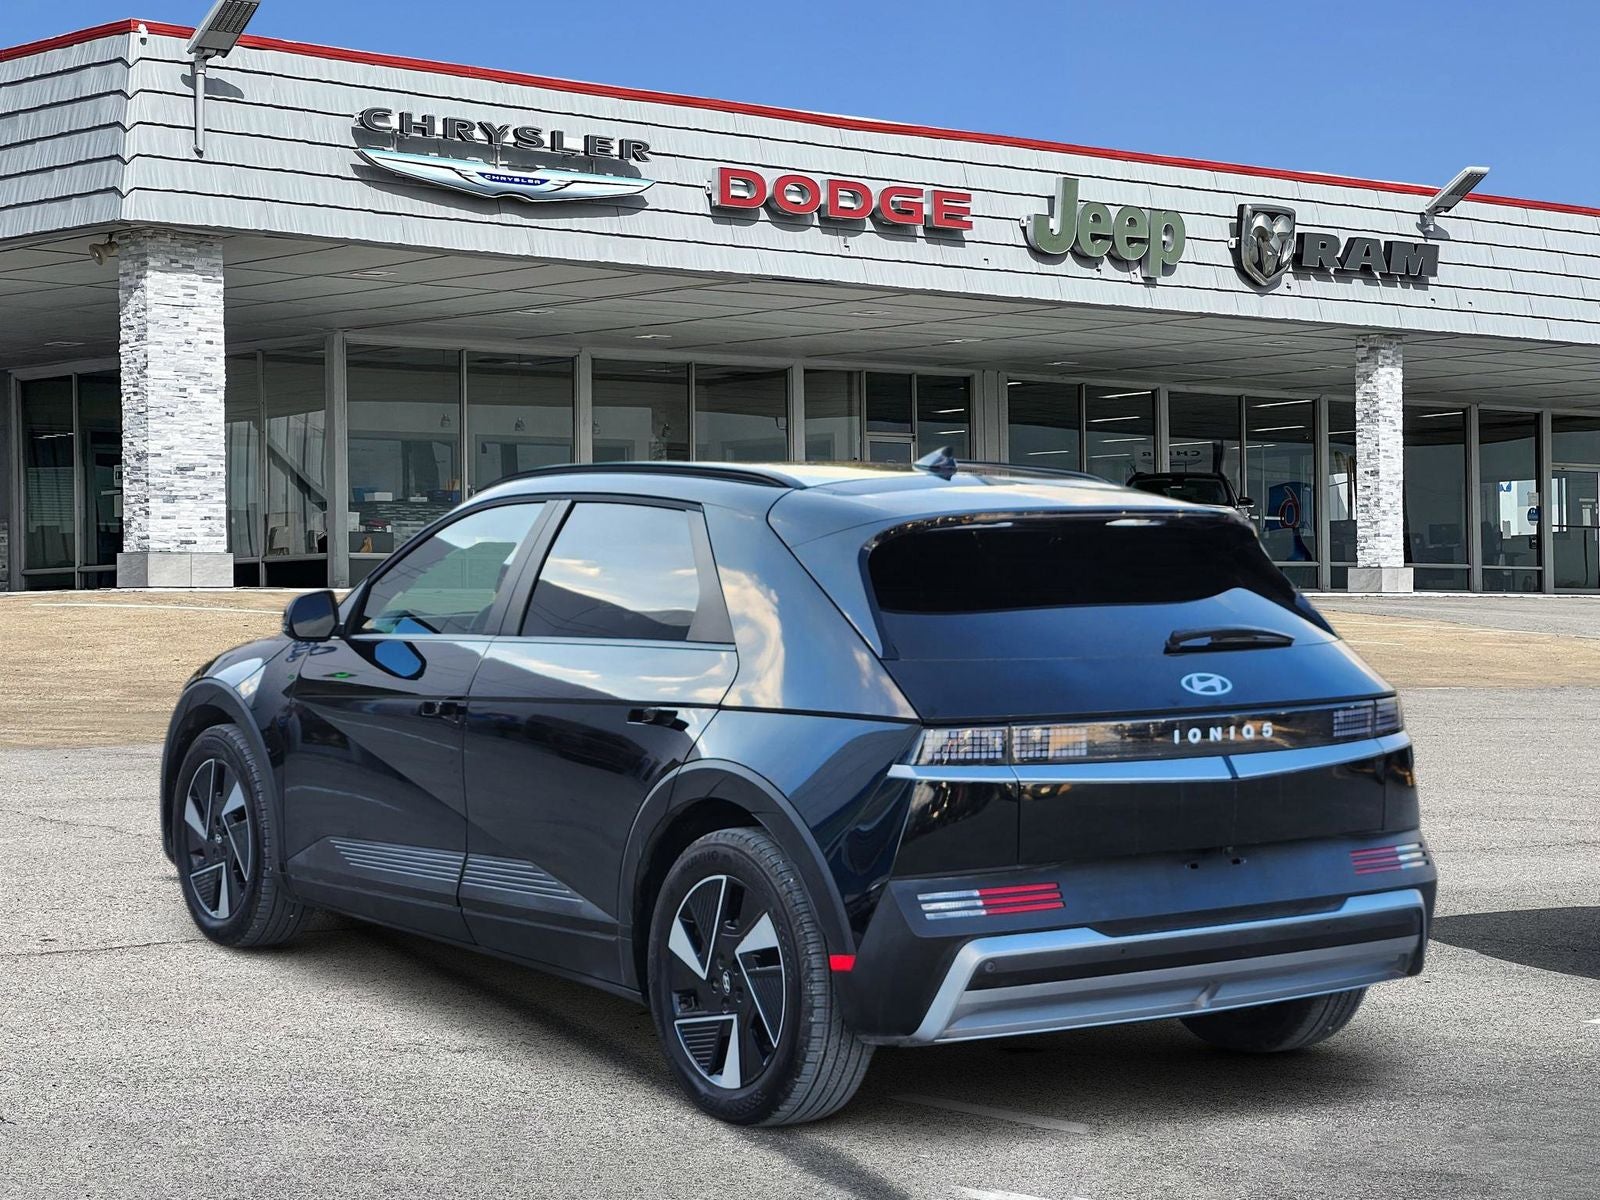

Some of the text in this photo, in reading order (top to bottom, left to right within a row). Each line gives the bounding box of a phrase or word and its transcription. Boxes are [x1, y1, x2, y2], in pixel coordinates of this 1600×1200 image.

[356, 106, 651, 162] CHRYSLER
[484, 174, 541, 184] CHRYSLER
[713, 166, 973, 231] DODGE
[1026, 176, 1186, 277] Jeep
[1296, 231, 1440, 278] RAM
